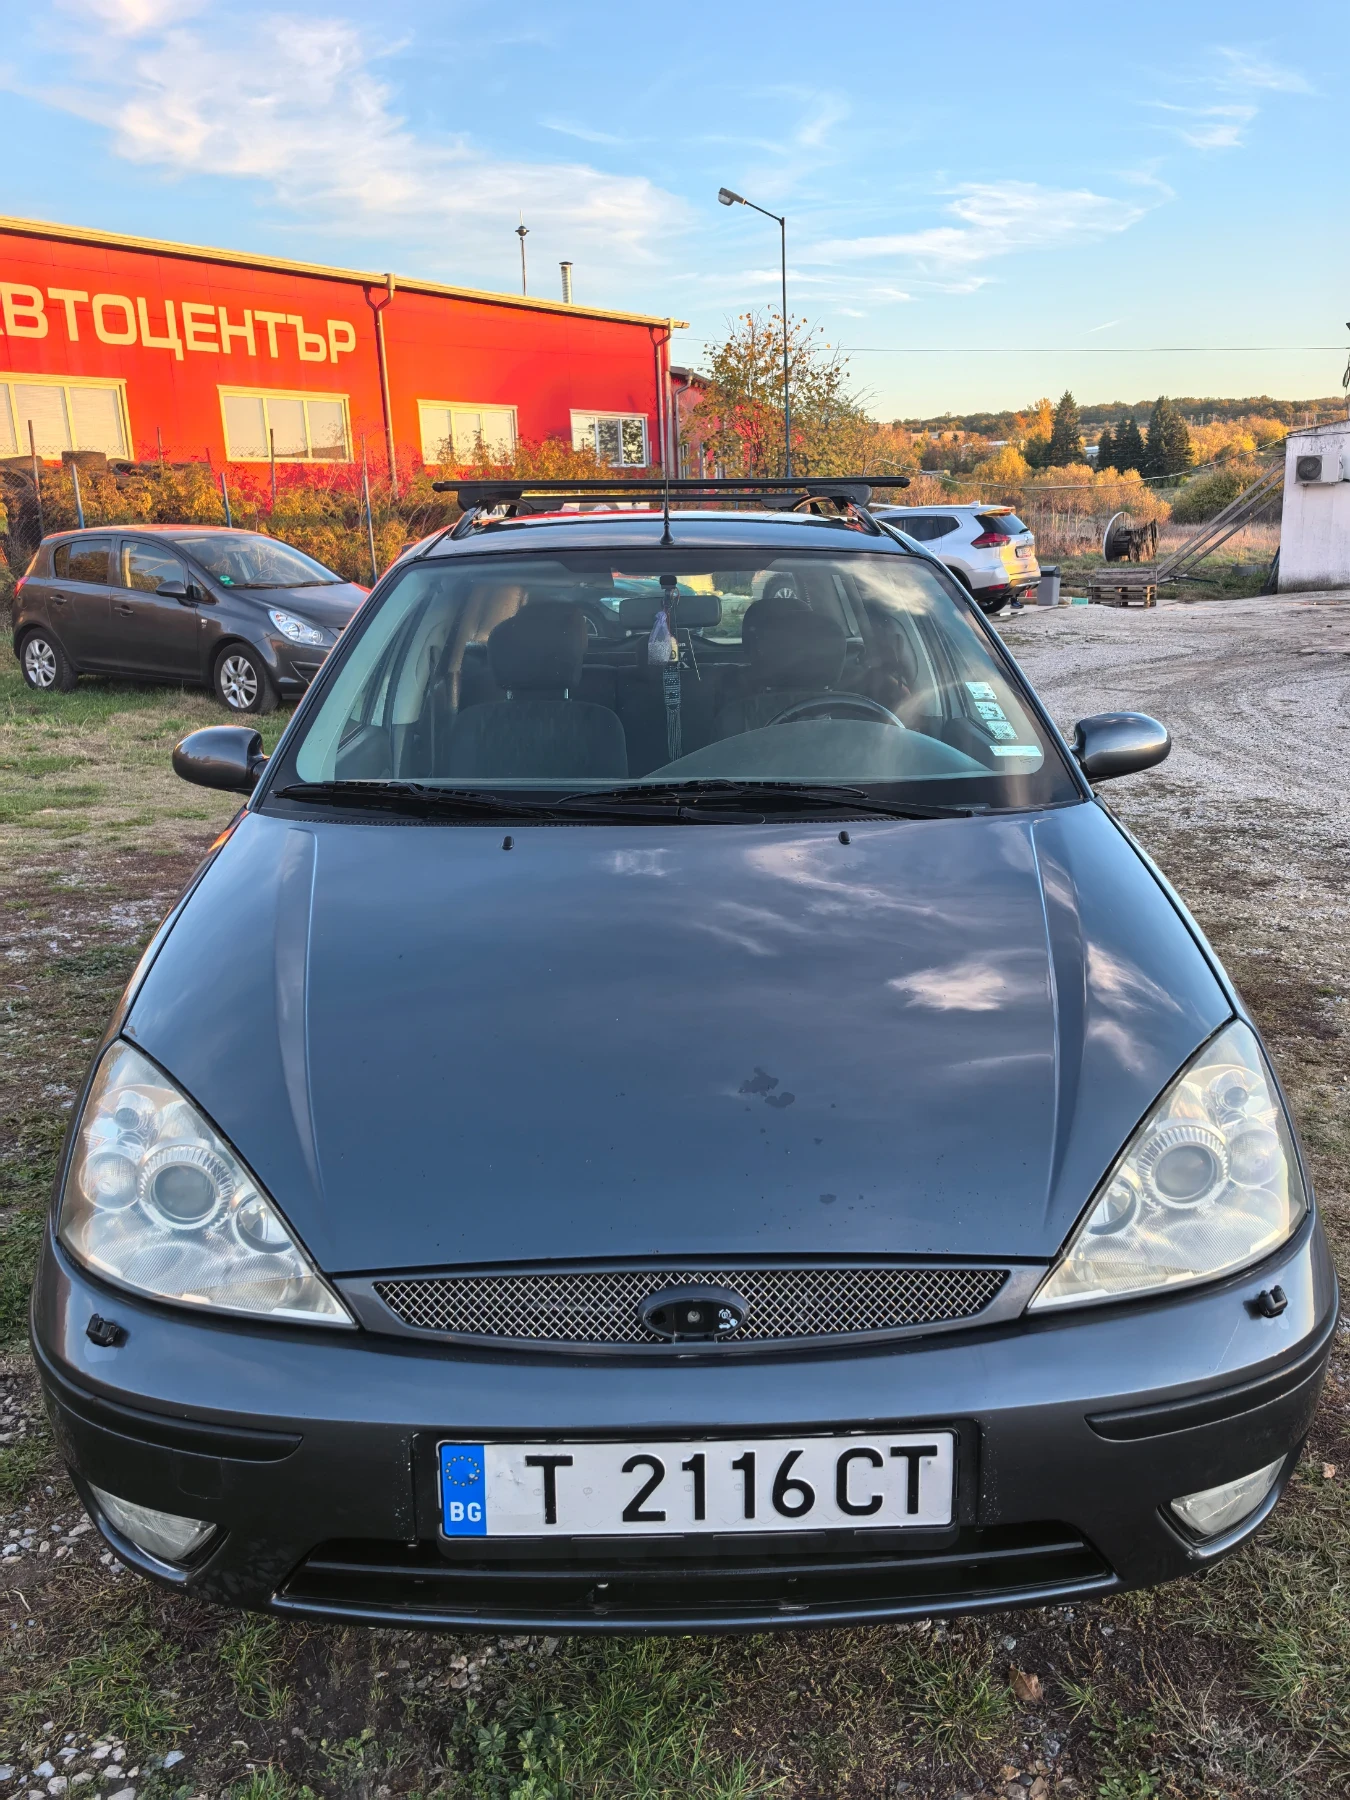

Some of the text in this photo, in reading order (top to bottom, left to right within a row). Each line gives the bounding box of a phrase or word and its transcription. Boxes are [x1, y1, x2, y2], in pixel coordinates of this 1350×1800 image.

[0, 282, 357, 364] ВТОЦЕНТЪР
[450, 1501, 482, 1522] BG
[525, 1454, 574, 1525] T
